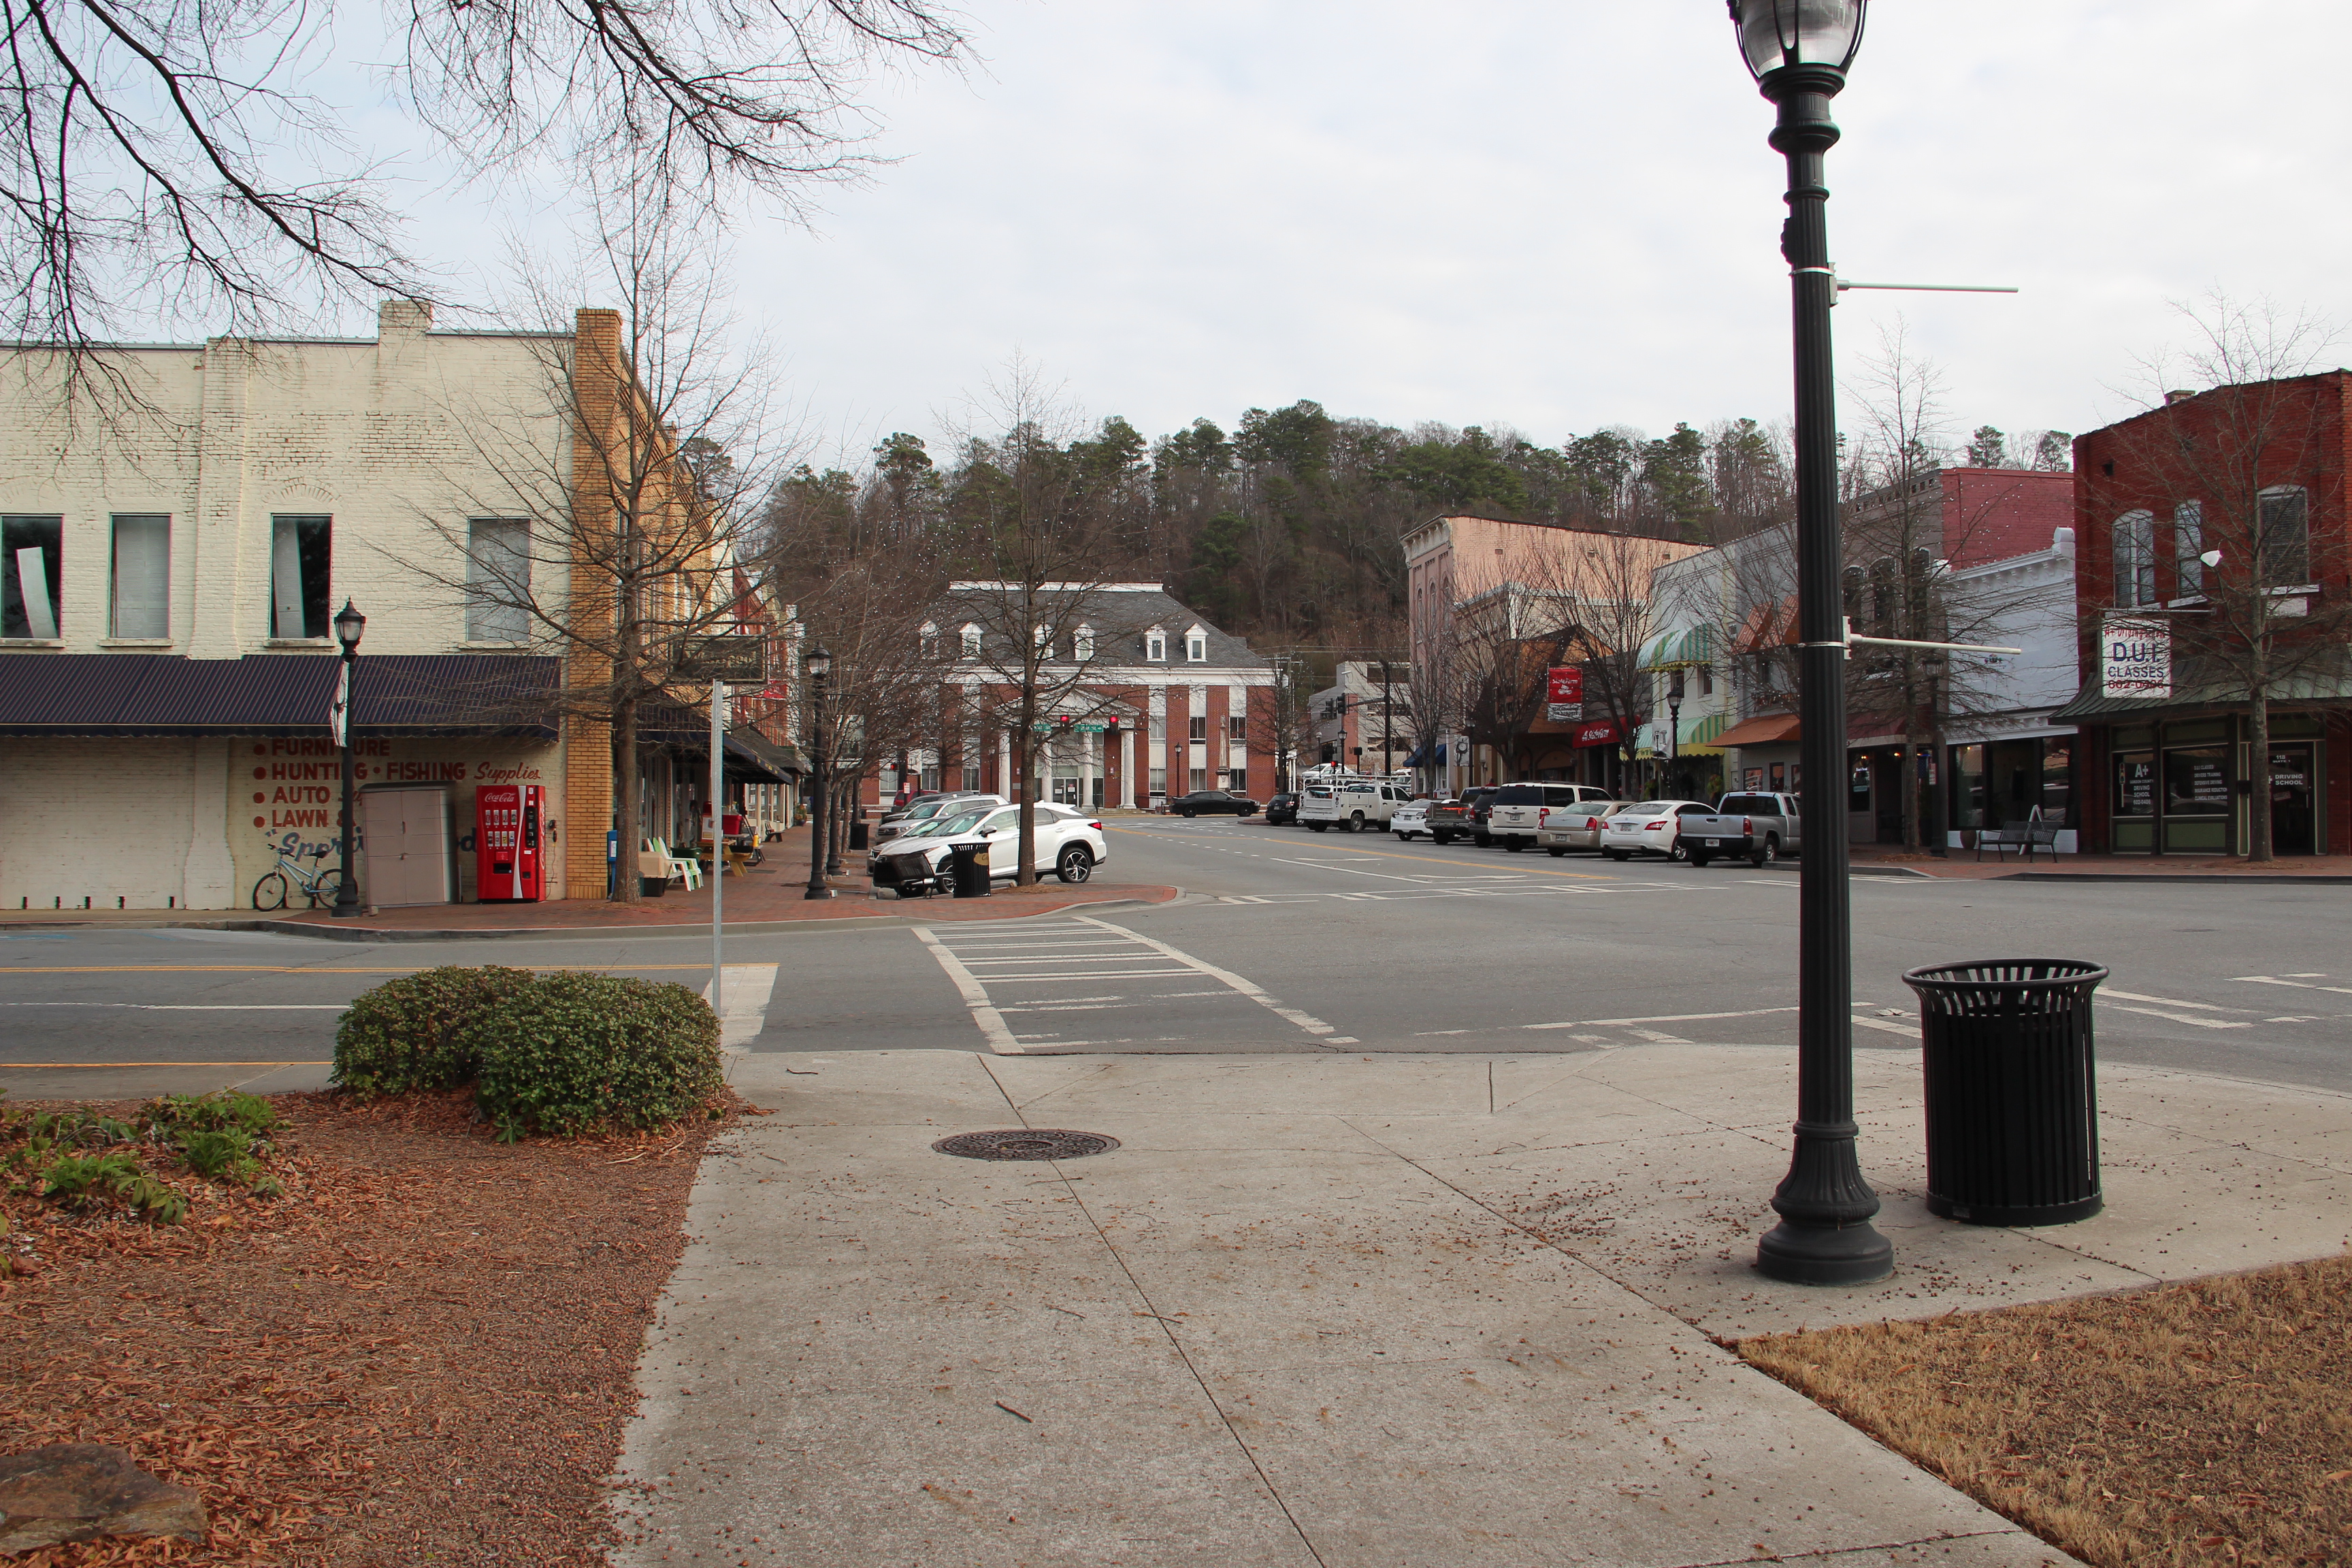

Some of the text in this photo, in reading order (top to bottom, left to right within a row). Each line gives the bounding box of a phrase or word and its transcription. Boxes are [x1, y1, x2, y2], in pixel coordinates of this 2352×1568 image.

[2113, 642, 2160, 662] D.U.I.
[2108, 666, 2164, 678] CLASSES
[272, 739, 390, 756] FURNIURE
[272, 762, 466, 781] HUNTIG FISHING
[474, 761, 542, 784] Supplies
[2135, 764, 2149, 778] A+
[272, 786, 330, 804] AUTO
[272, 809, 328, 828] LAWN
